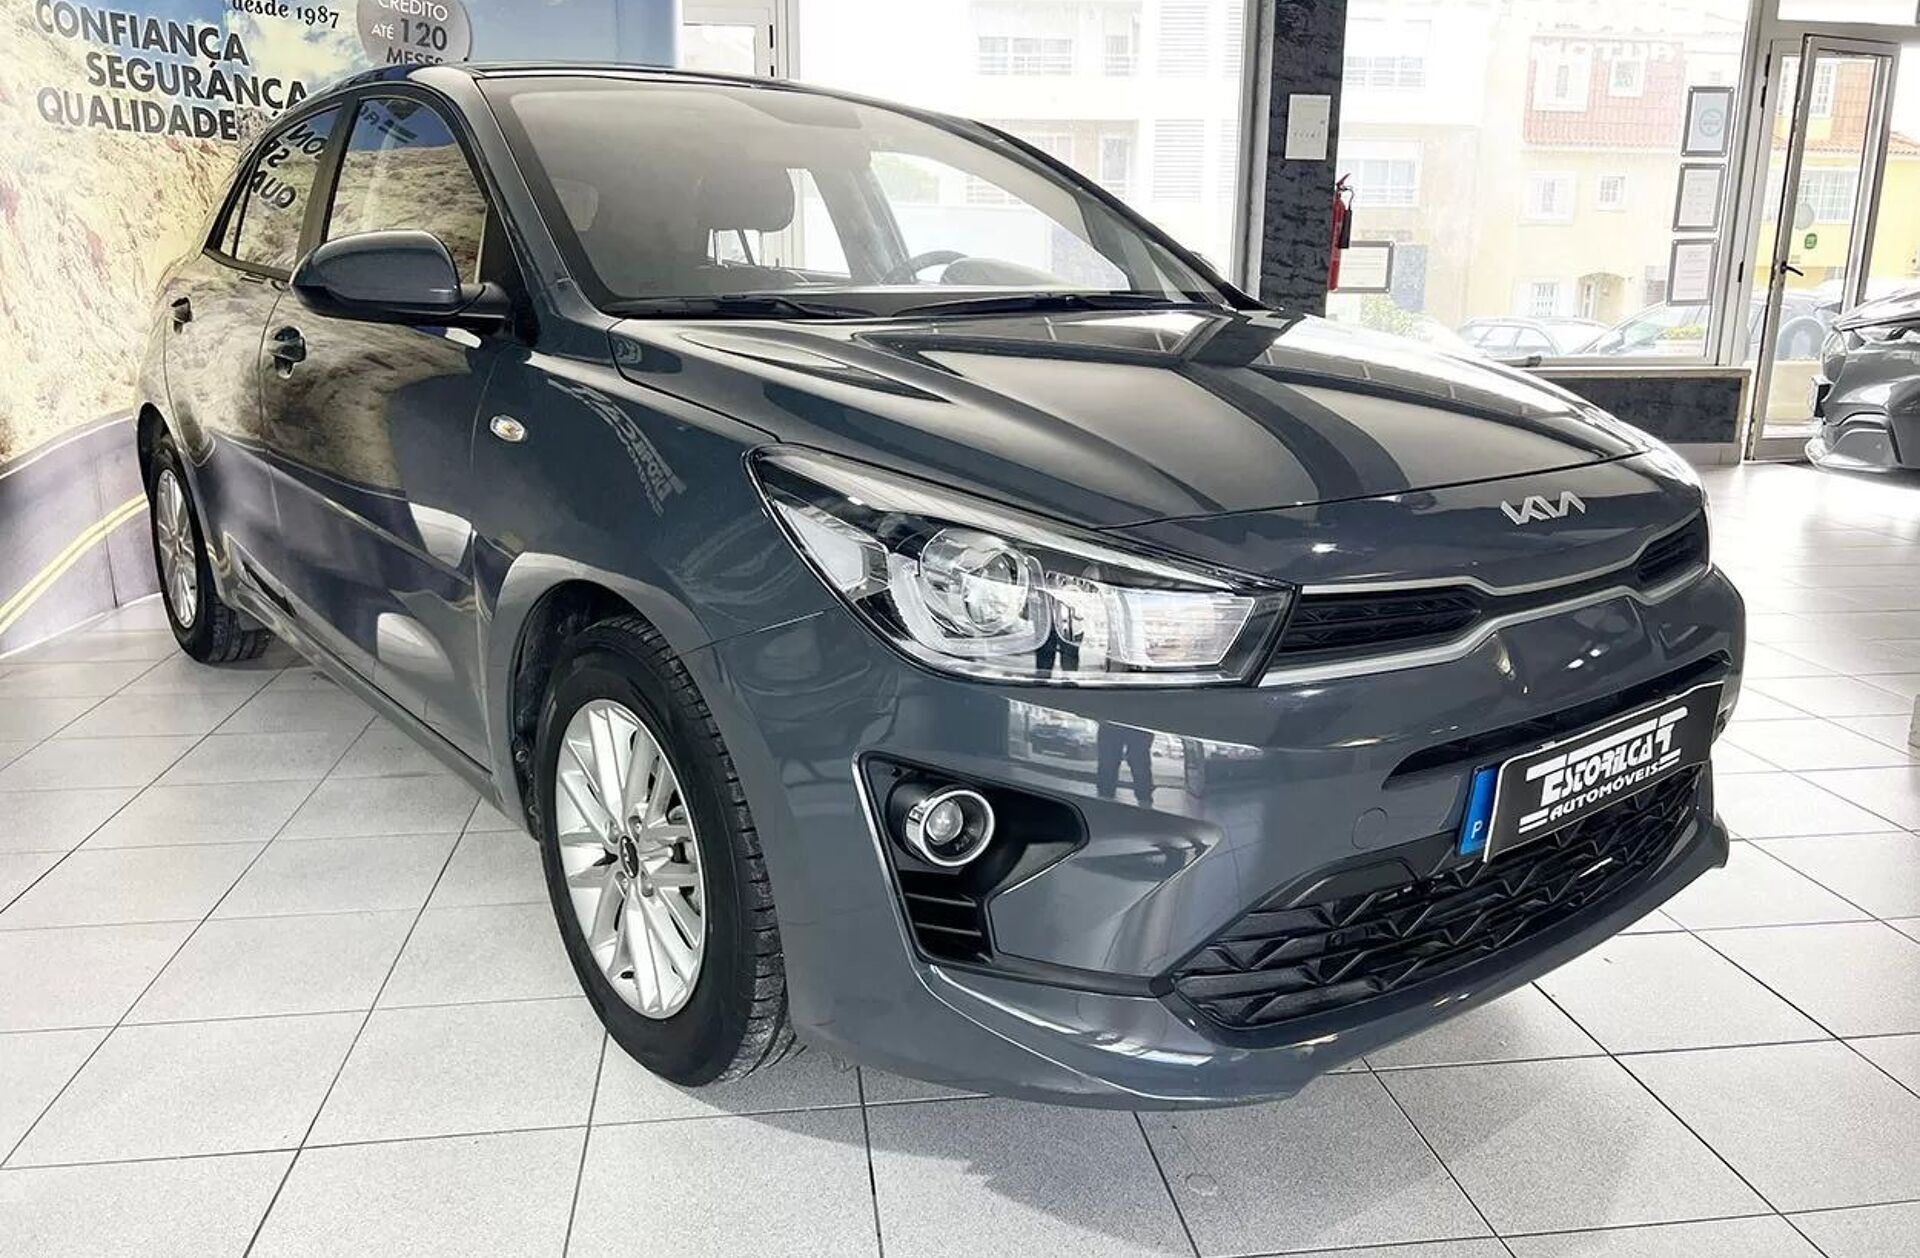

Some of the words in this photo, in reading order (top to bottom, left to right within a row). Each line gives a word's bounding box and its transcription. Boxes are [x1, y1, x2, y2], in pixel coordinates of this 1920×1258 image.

[35, 0, 249, 68] CONFIANÇA
[232, 0, 288, 18] desde
[297, 5, 339, 29] 1987
[371, 23, 395, 40] ATÉ
[400, 18, 447, 51] 120
[86, 52, 307, 117] SEGURANÇA
[37, 87, 238, 141] QUALIDADE
[1470, 820, 1483, 840] P
